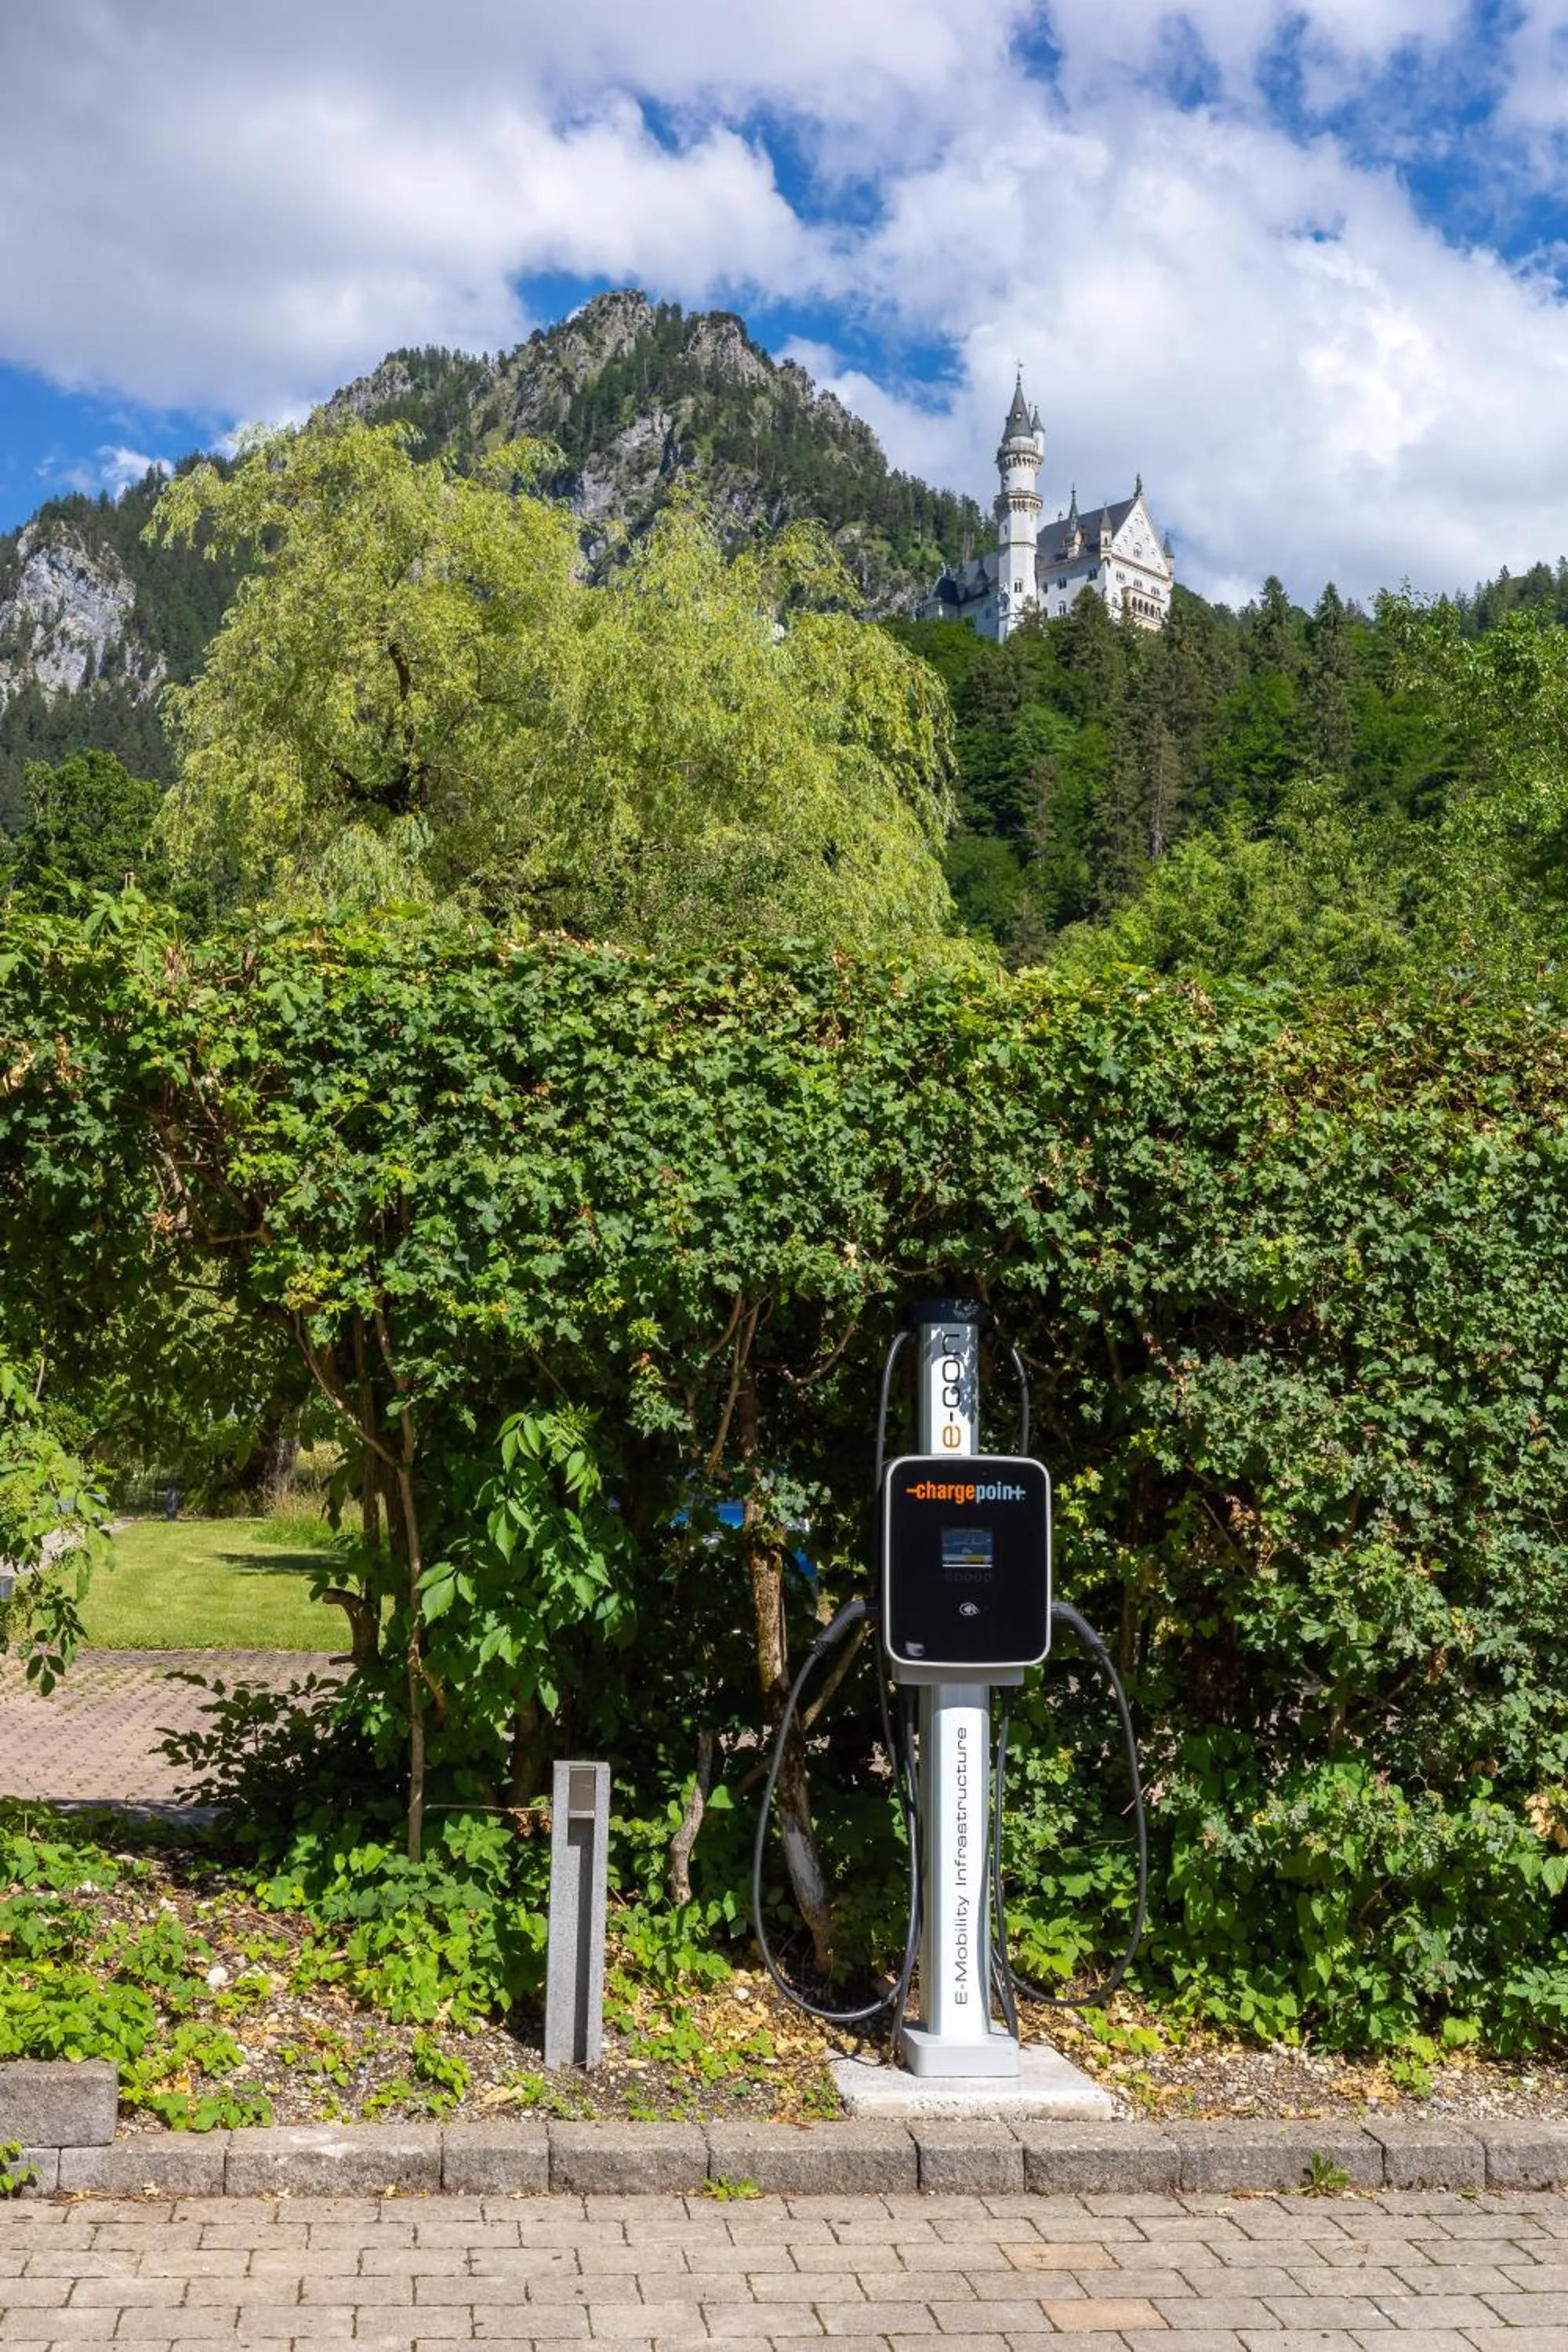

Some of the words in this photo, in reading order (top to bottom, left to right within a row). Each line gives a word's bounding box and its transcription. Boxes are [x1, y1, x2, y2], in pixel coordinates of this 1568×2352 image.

[942, 1334, 961, 1448] e-con
[954, 1726, 968, 1885] Infrastructure
[953, 1894, 969, 2005] E-Mobility
